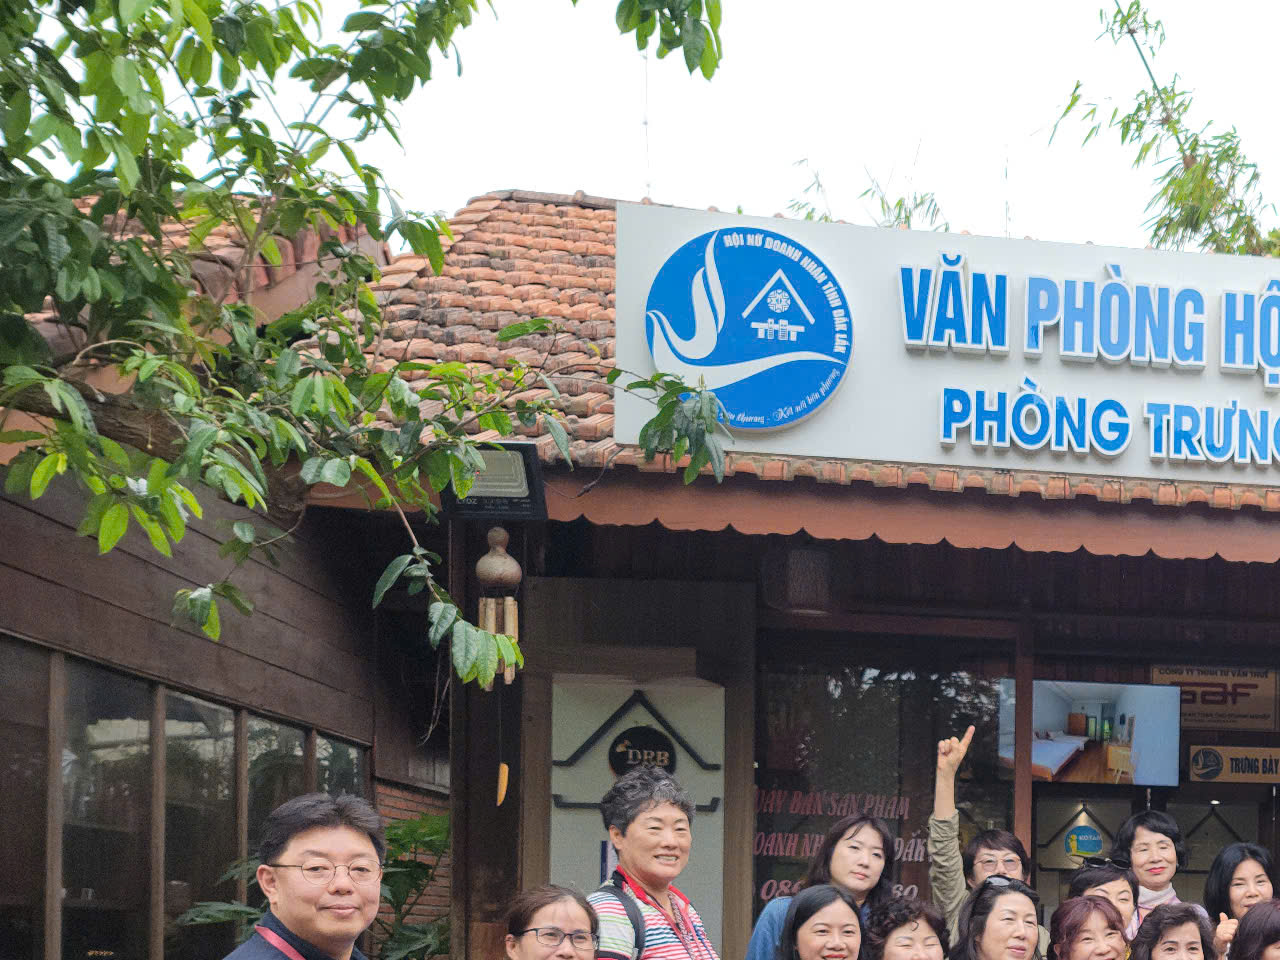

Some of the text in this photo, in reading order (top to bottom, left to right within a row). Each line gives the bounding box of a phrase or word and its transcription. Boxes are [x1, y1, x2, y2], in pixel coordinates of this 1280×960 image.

[723, 232, 745, 248] HỘI
[763, 236, 803, 262] DOANH
[900, 252, 1007, 348] VĂN
[1026, 263, 1204, 363] PHÒNG
[942, 377, 1131, 453] PHÒNG
[1230, 756, 1259, 774] TRƯNG
[1262, 754, 1280, 775] BÀY
